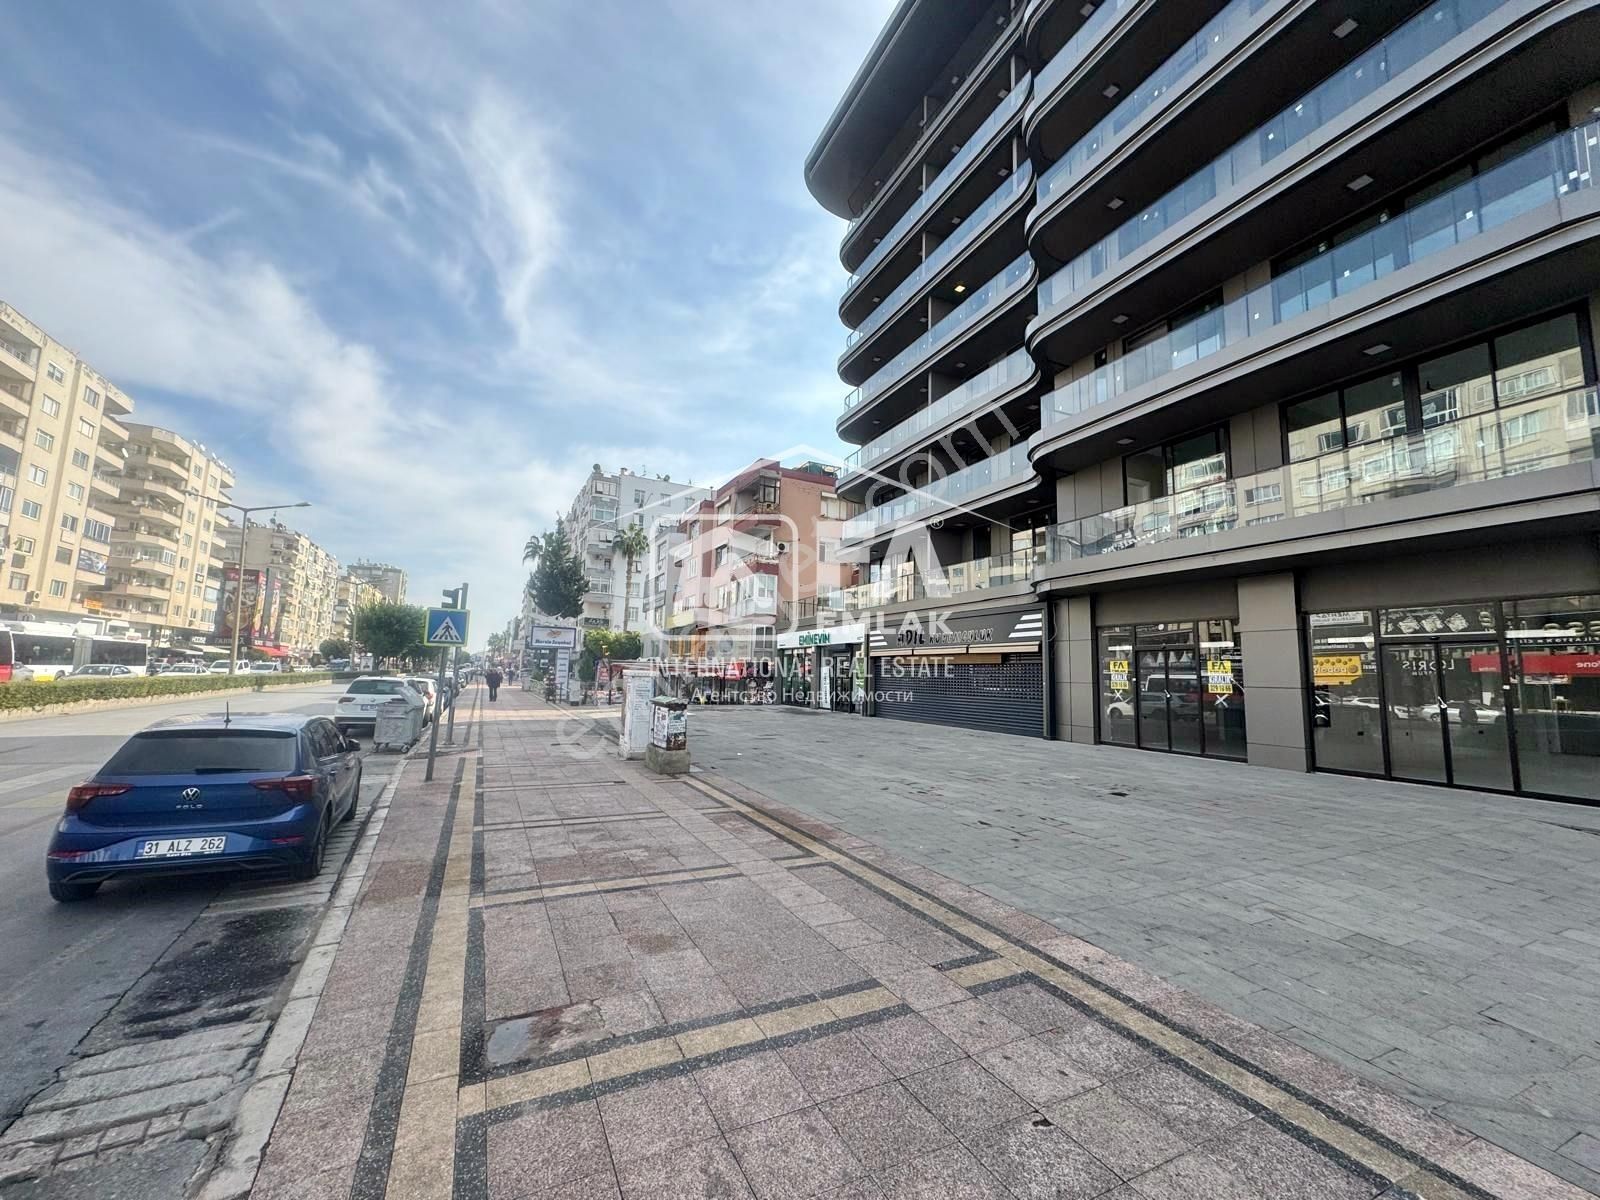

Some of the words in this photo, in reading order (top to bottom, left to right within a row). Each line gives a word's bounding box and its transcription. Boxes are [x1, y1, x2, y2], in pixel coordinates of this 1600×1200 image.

[145, 842, 160, 854] 31
[167, 840, 192, 852] ALZ
[200, 837, 224, 850] 262
